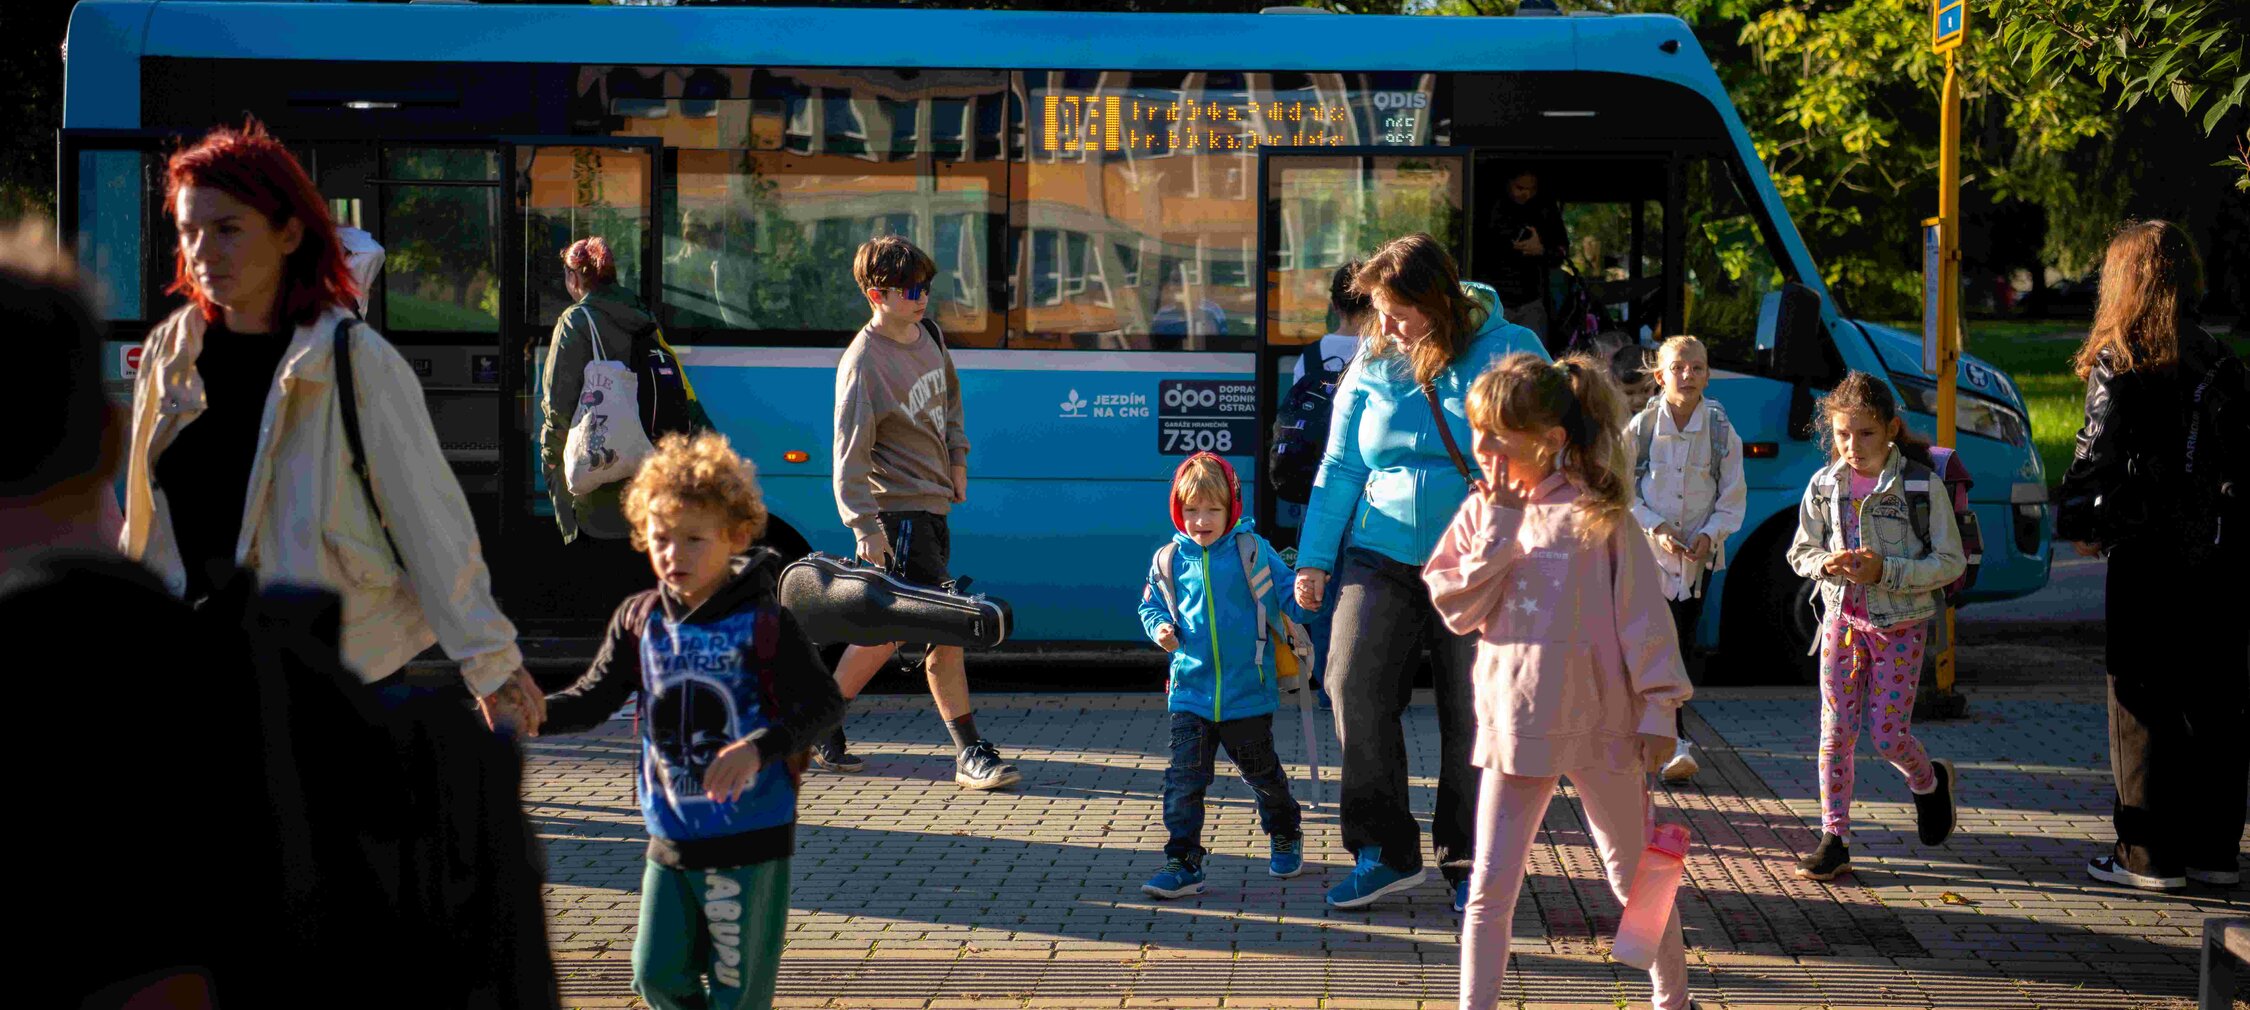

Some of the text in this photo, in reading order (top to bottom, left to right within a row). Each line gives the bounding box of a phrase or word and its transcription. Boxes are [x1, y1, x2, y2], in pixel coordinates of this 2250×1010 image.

[1093, 392, 1145, 405] JEZDÍM
[1093, 407, 1150, 417] NA CNG
[1163, 429, 1232, 451] 7308
